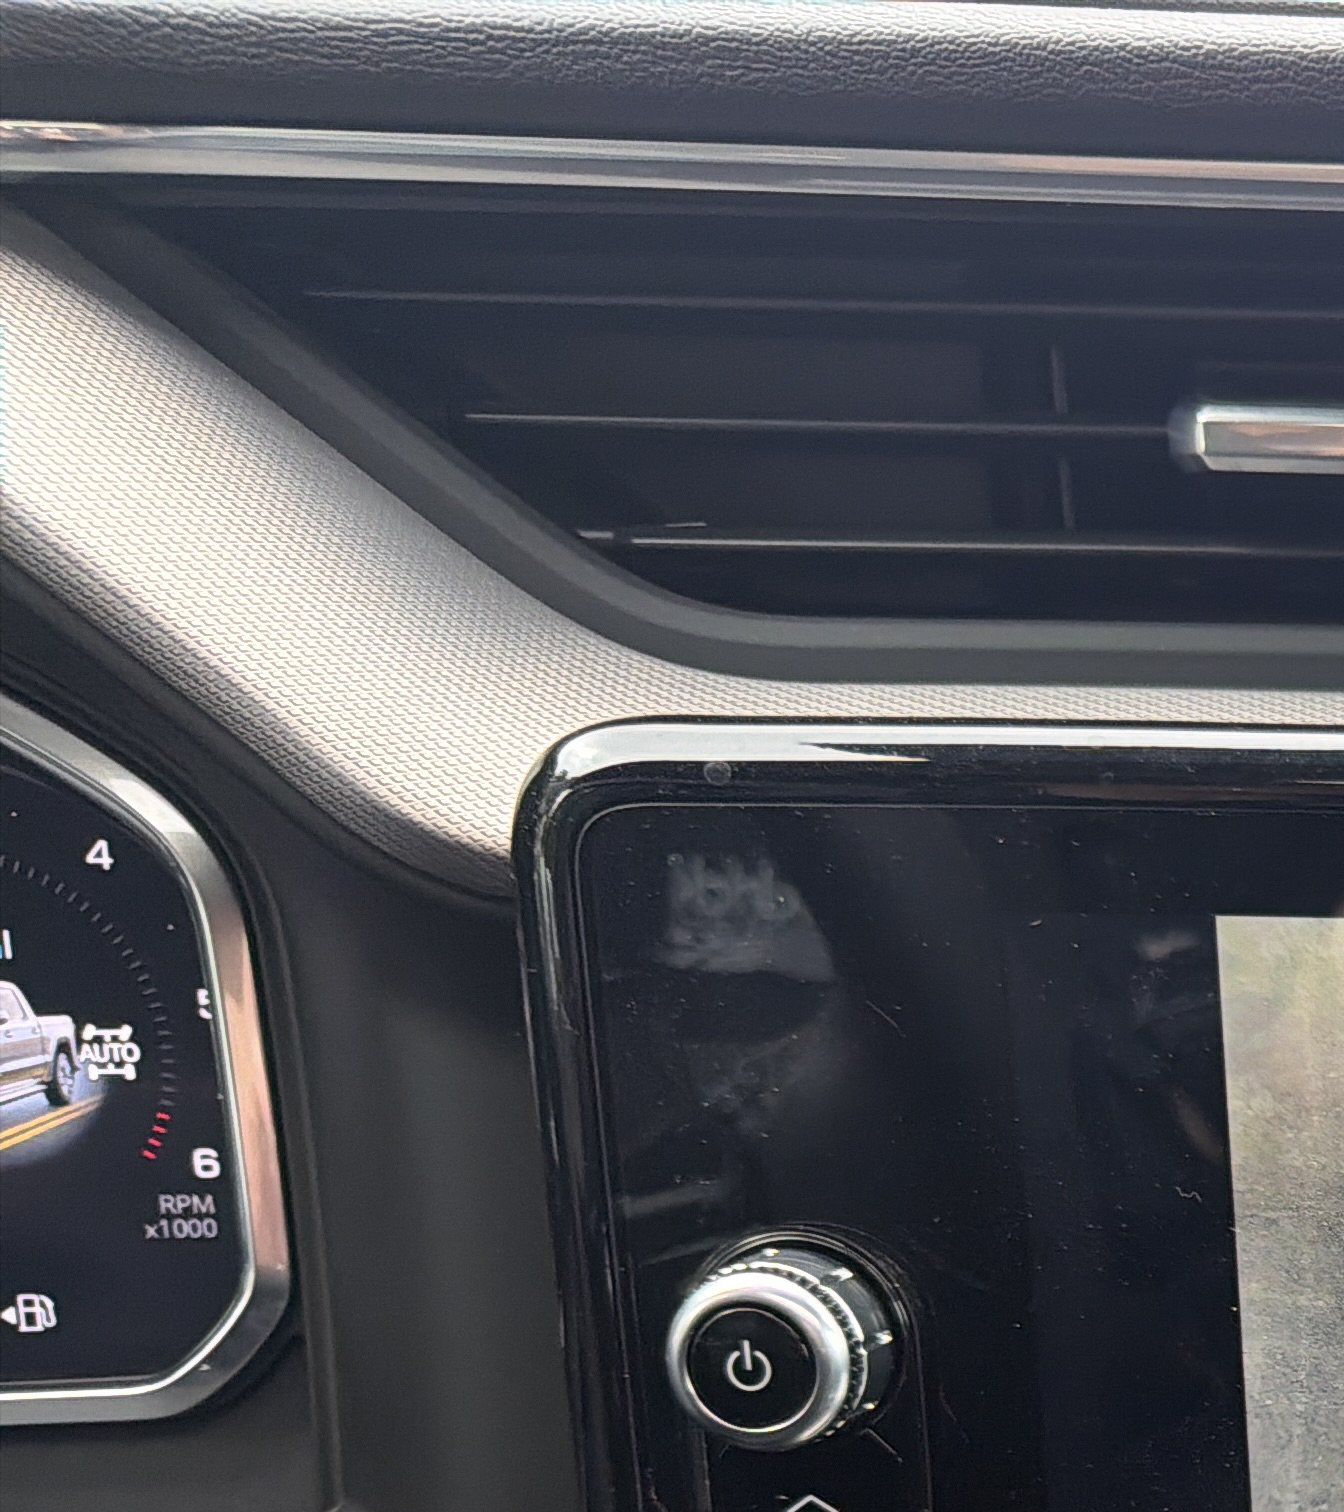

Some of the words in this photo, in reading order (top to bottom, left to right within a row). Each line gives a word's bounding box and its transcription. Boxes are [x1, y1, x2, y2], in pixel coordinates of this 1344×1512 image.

[85, 839, 115, 872] 4
[79, 1040, 141, 1065] AUTO
[192, 1146, 221, 1180] 6
[158, 1193, 215, 1214] RPM
[144, 1216, 218, 1239] x1000
